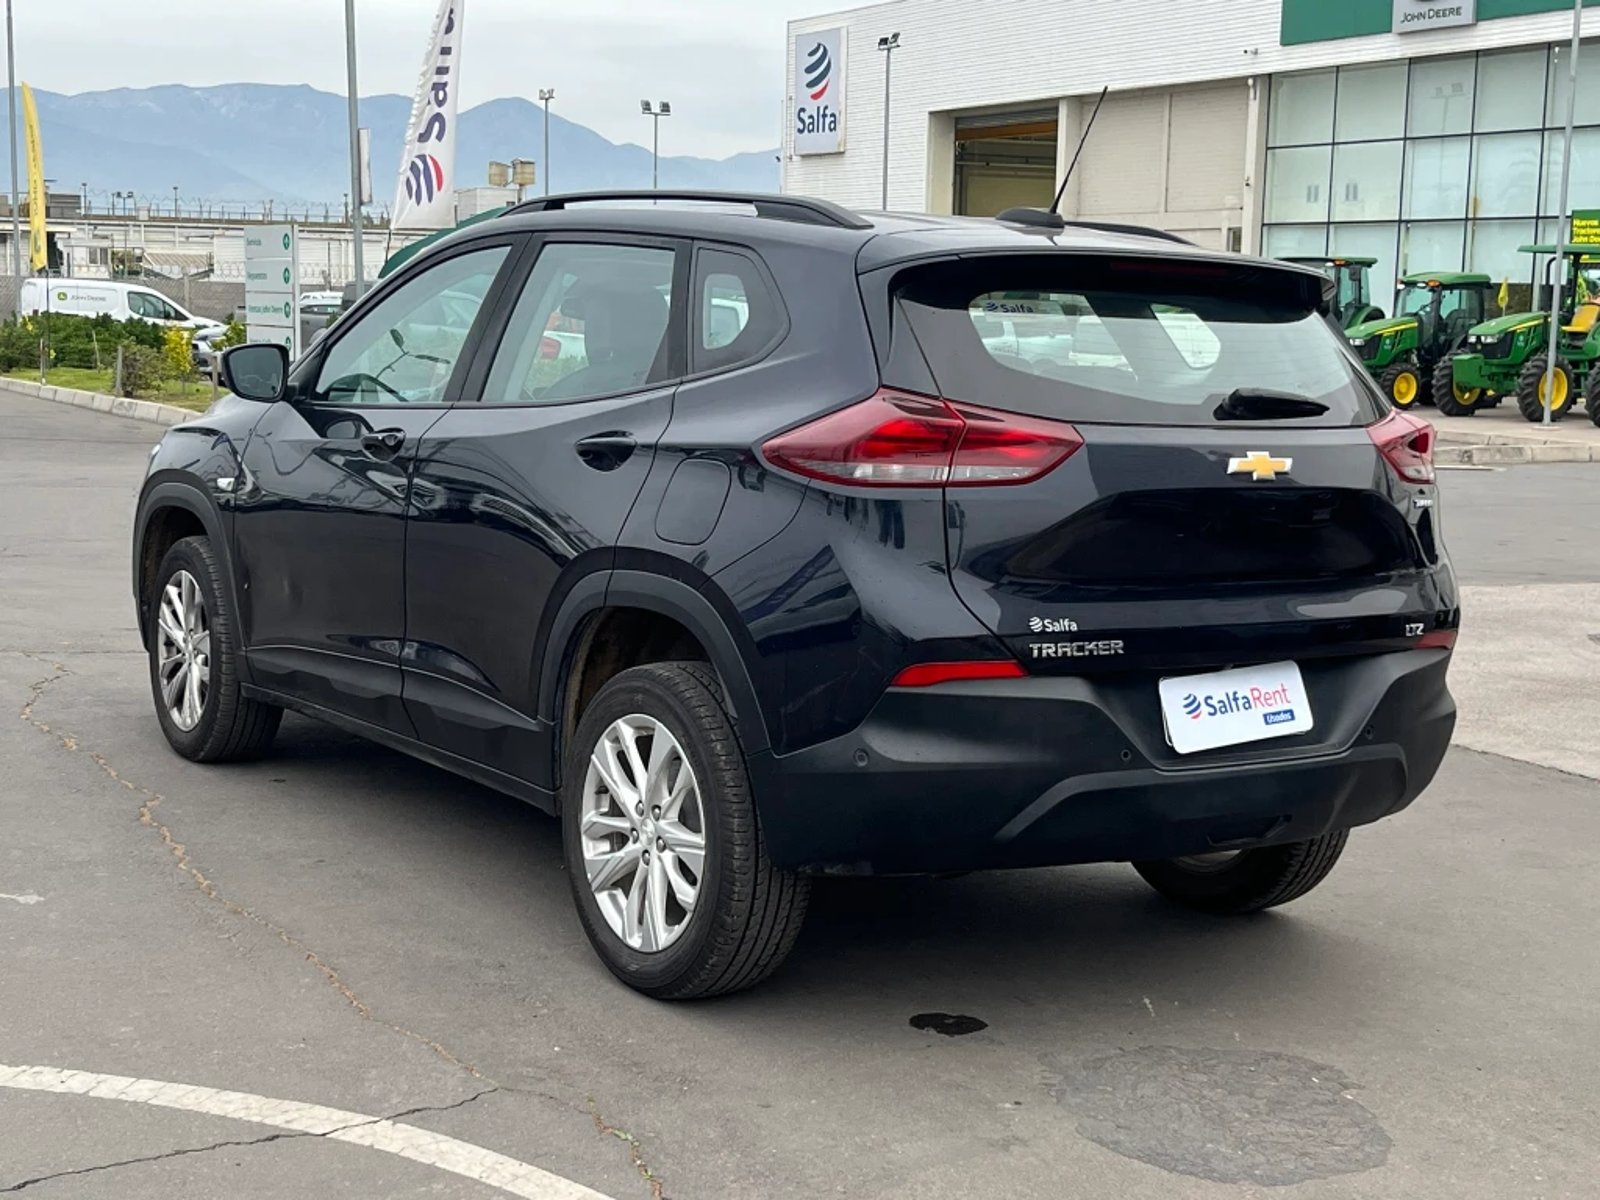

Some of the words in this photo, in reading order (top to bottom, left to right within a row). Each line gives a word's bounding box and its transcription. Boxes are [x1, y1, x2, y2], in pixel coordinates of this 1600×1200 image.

[1400, 12, 1426, 24] JOHN
[1427, 6, 1462, 20] DEERE
[797, 105, 837, 135] Salfa
[1000, 303, 1034, 313] Salfa
[1043, 618, 1078, 633] Salfa
[1405, 622, 1425, 637] LTZ
[1028, 639, 1125, 658] TRACKER
[1203, 683, 1292, 717] SalfaRent
